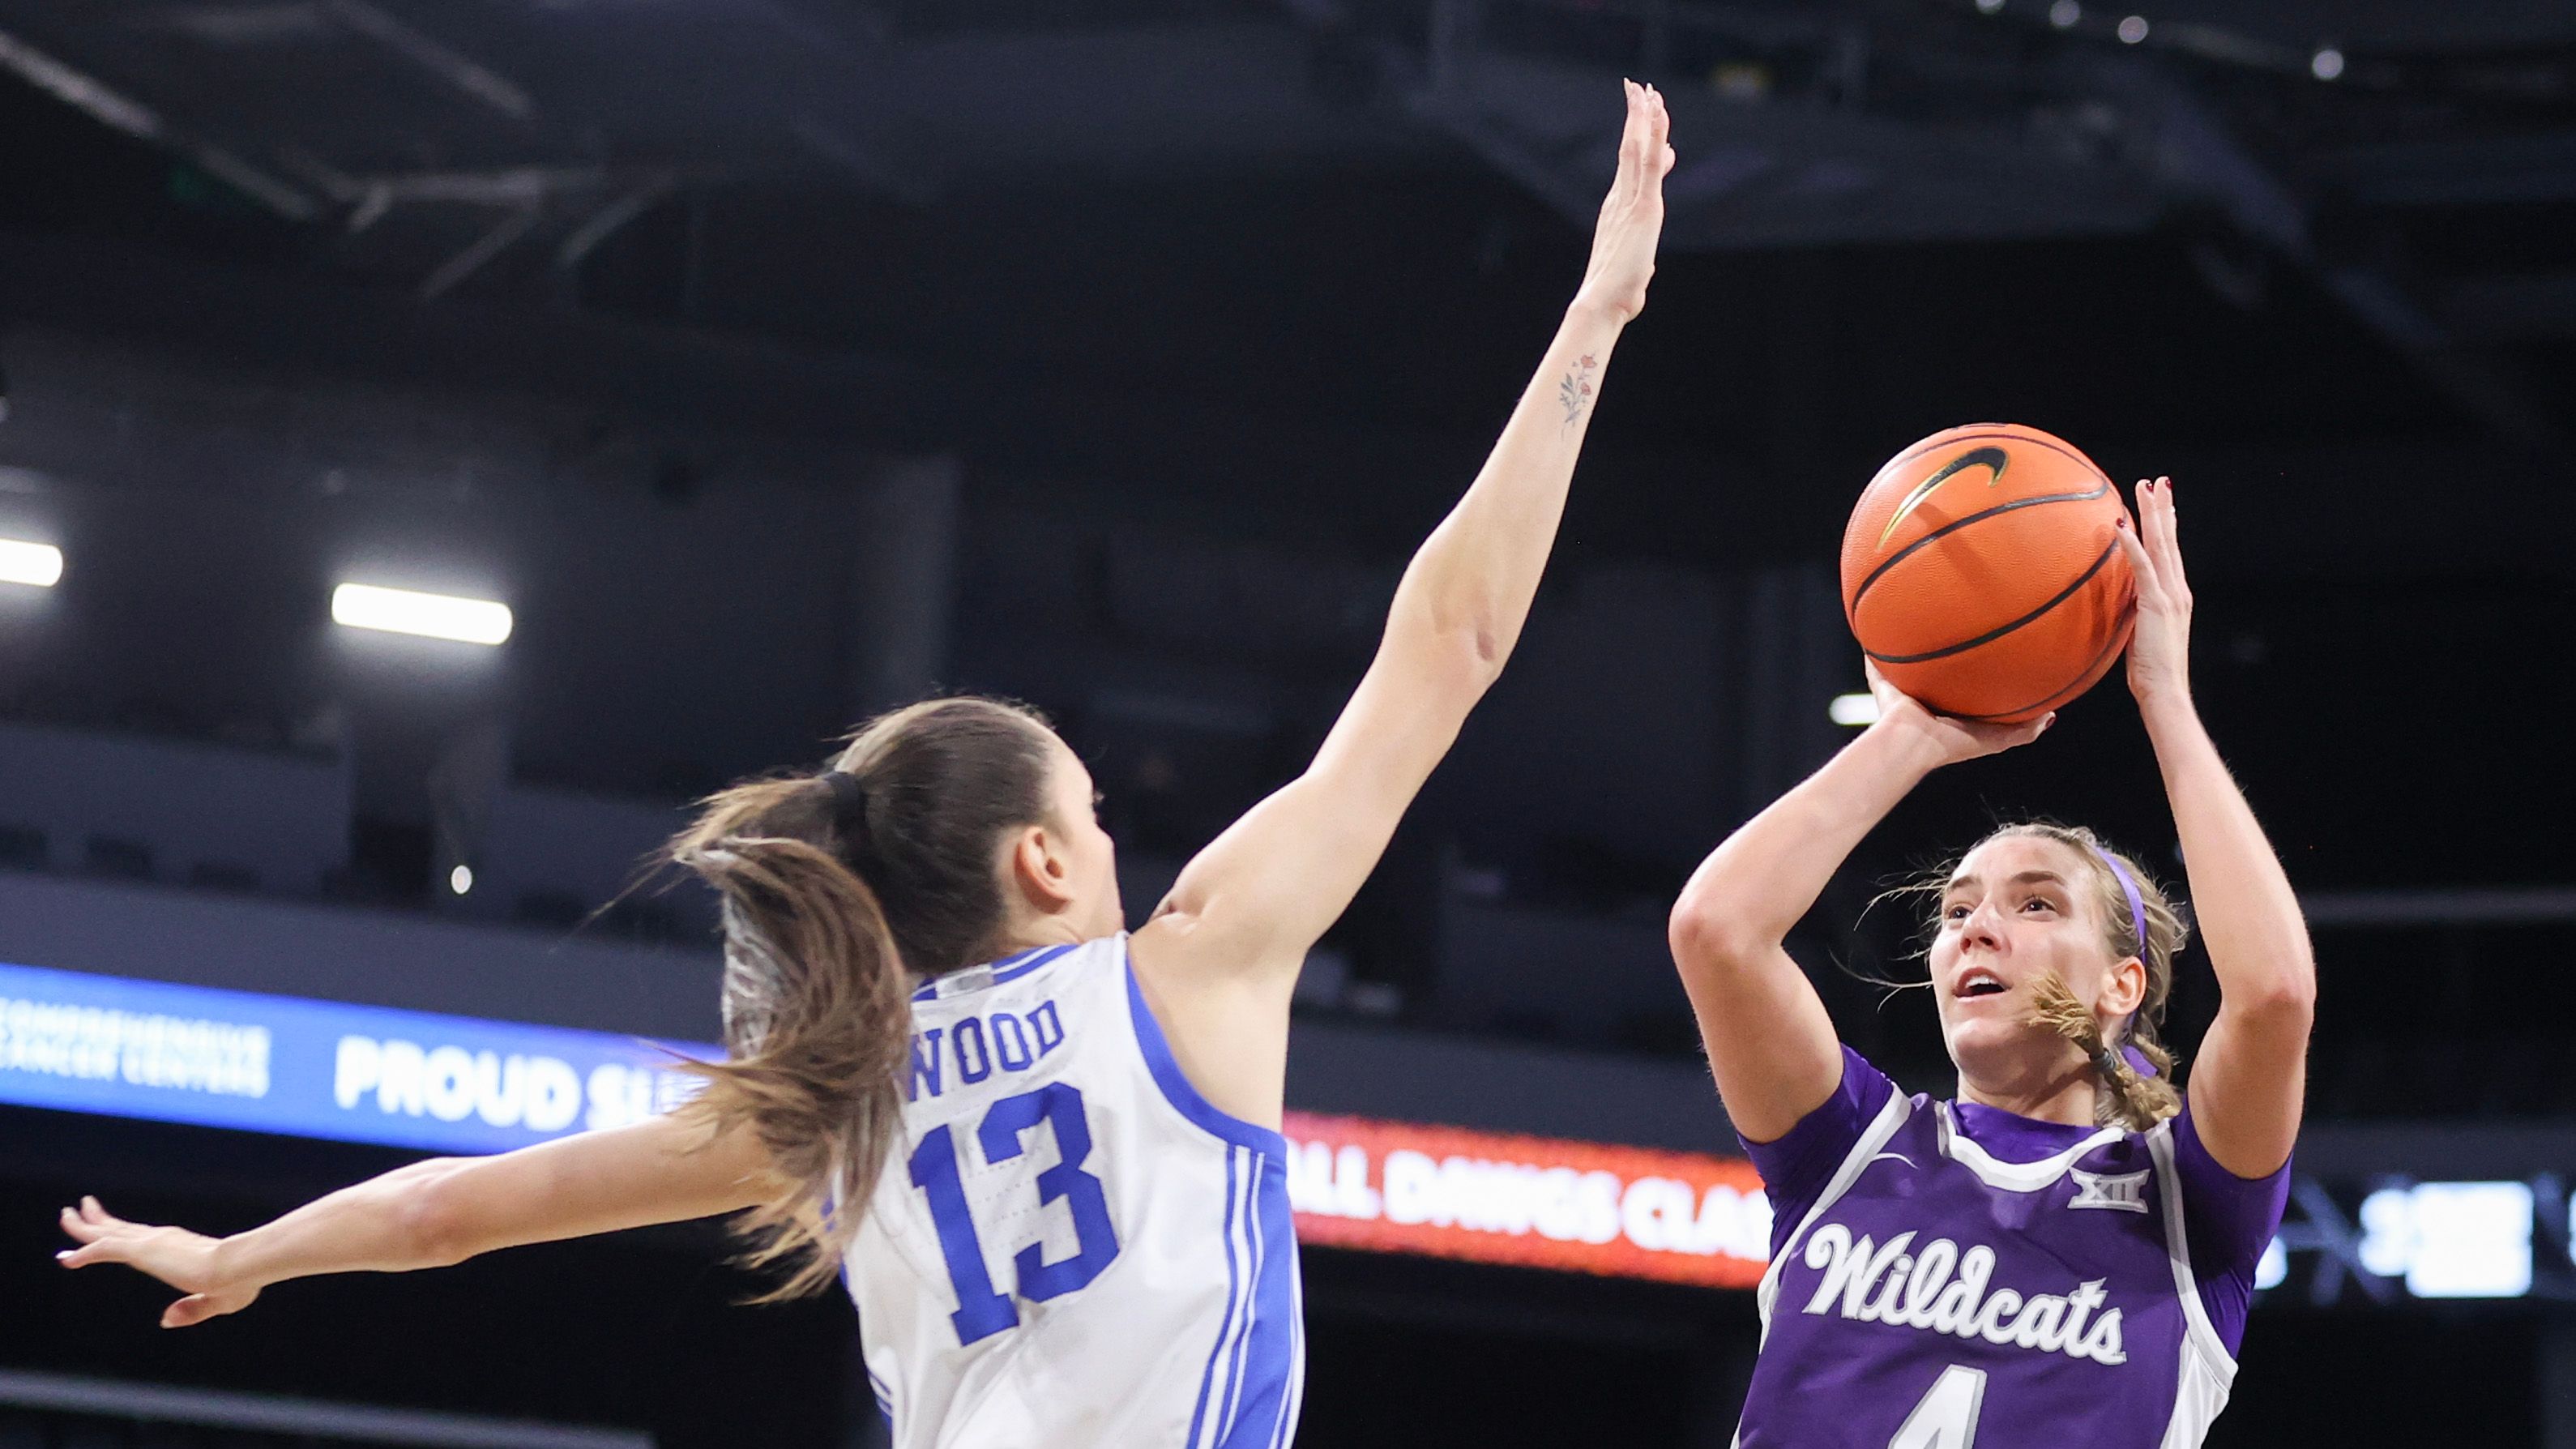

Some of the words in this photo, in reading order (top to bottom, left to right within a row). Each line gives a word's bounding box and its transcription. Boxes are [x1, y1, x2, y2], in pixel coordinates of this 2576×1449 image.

[335, 1036, 582, 1131] PROUD
[905, 1000, 1065, 1102] WOOD
[908, 1081, 1119, 1347] 13
[2067, 1166, 2151, 1213] XII
[1801, 1223, 2127, 1366] Wildcats
